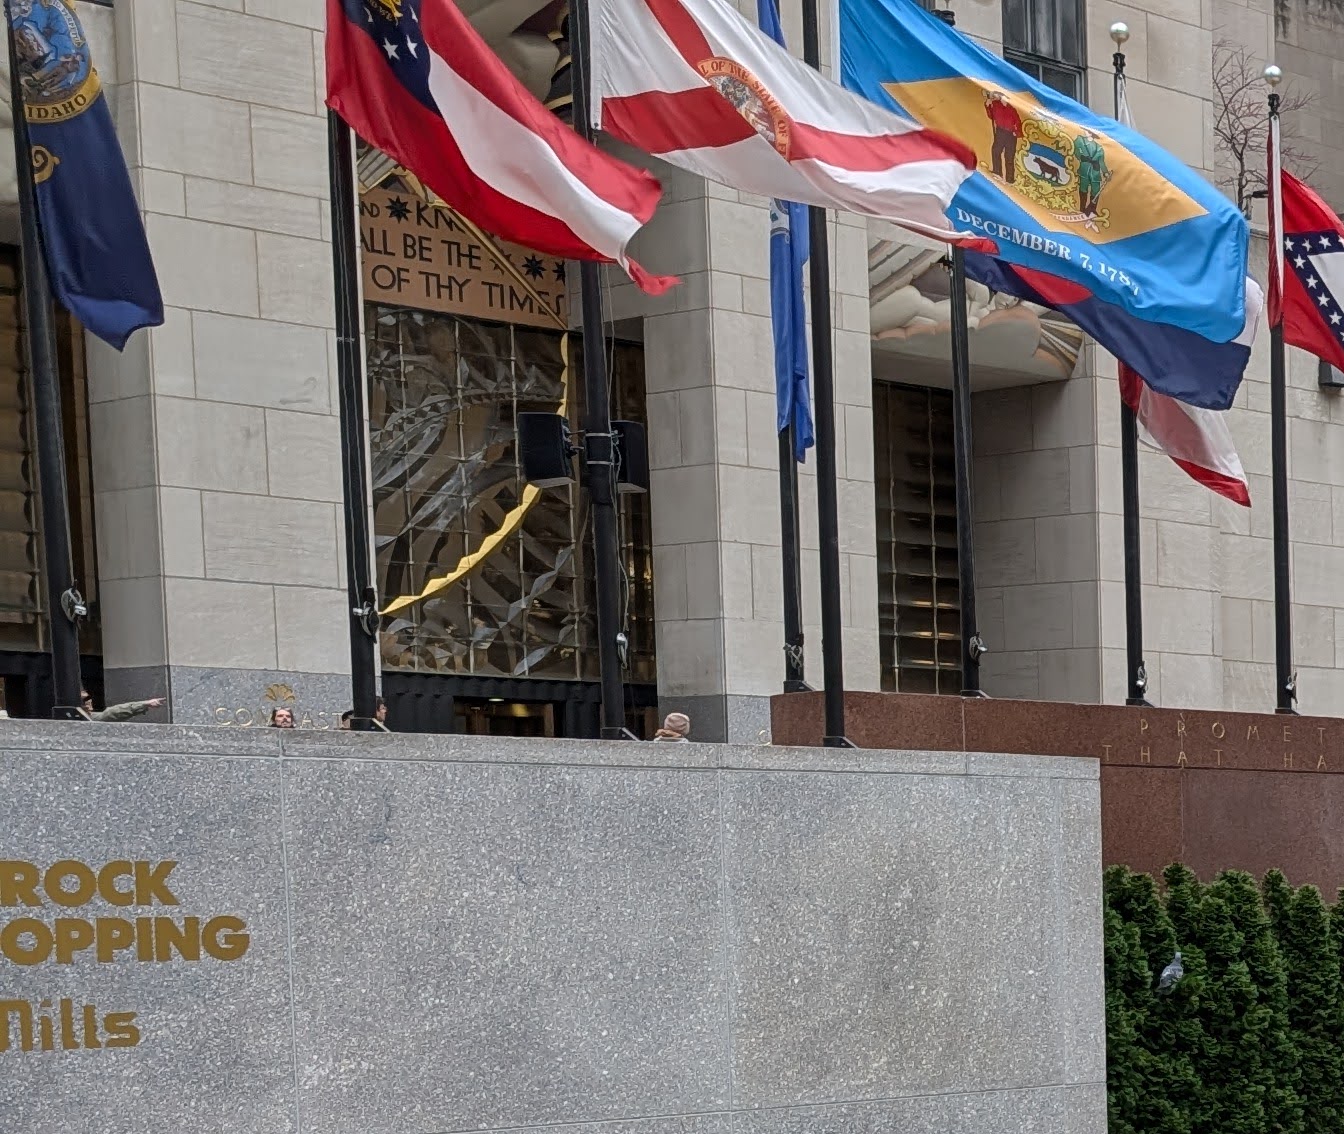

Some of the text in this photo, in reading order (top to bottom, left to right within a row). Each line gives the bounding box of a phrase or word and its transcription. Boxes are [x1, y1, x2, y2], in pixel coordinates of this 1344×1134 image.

[27, 94, 87, 118] IDAHO
[359, 202, 380, 218] ND
[403, 233, 432, 263] BE
[441, 239, 481, 271] THE
[957, 208, 1071, 260] DECEMBER
[1080, 253, 1093, 271] 7,
[371, 264, 565, 316] OF THY TIMES
[1101, 744, 1224, 766] THAT
[0, 915, 250, 965] OPPING
